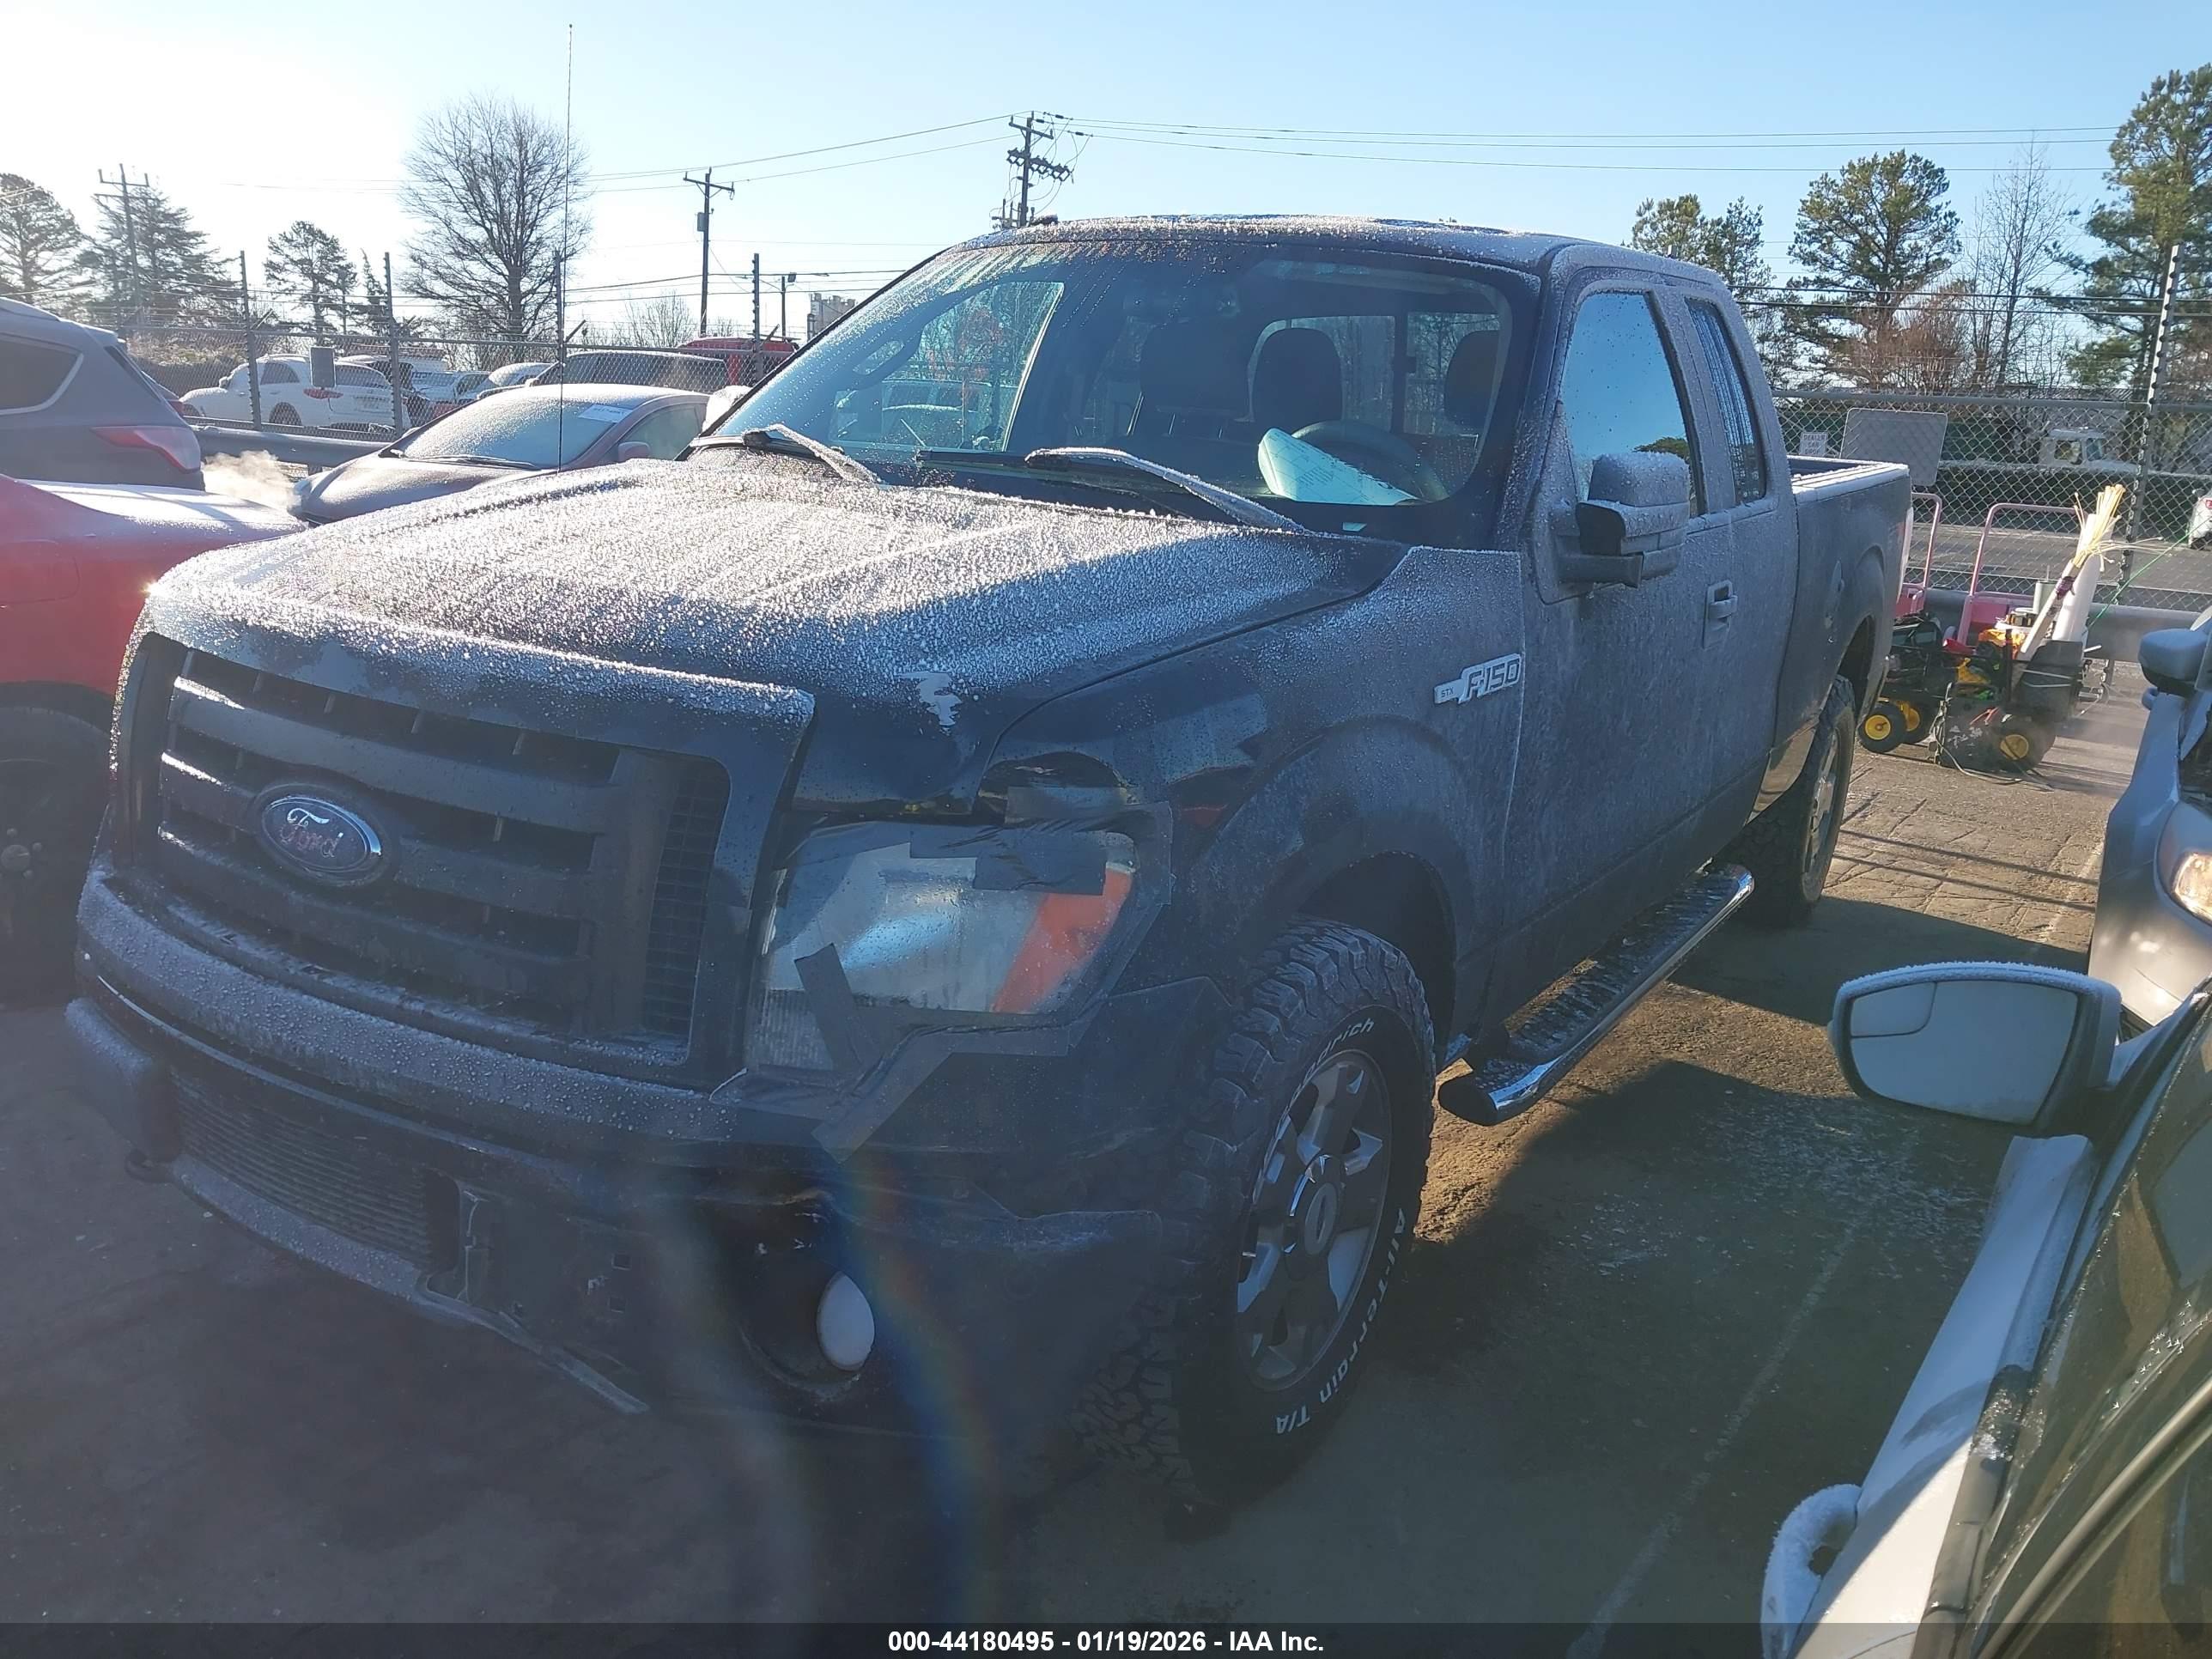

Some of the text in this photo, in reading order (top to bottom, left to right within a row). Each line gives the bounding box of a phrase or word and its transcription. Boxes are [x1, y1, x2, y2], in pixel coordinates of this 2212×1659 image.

[1441, 686, 1454, 698] STX
[280, 807, 344, 858] Ford
[1276, 1207, 1406, 1435] All-Terrain T/A
